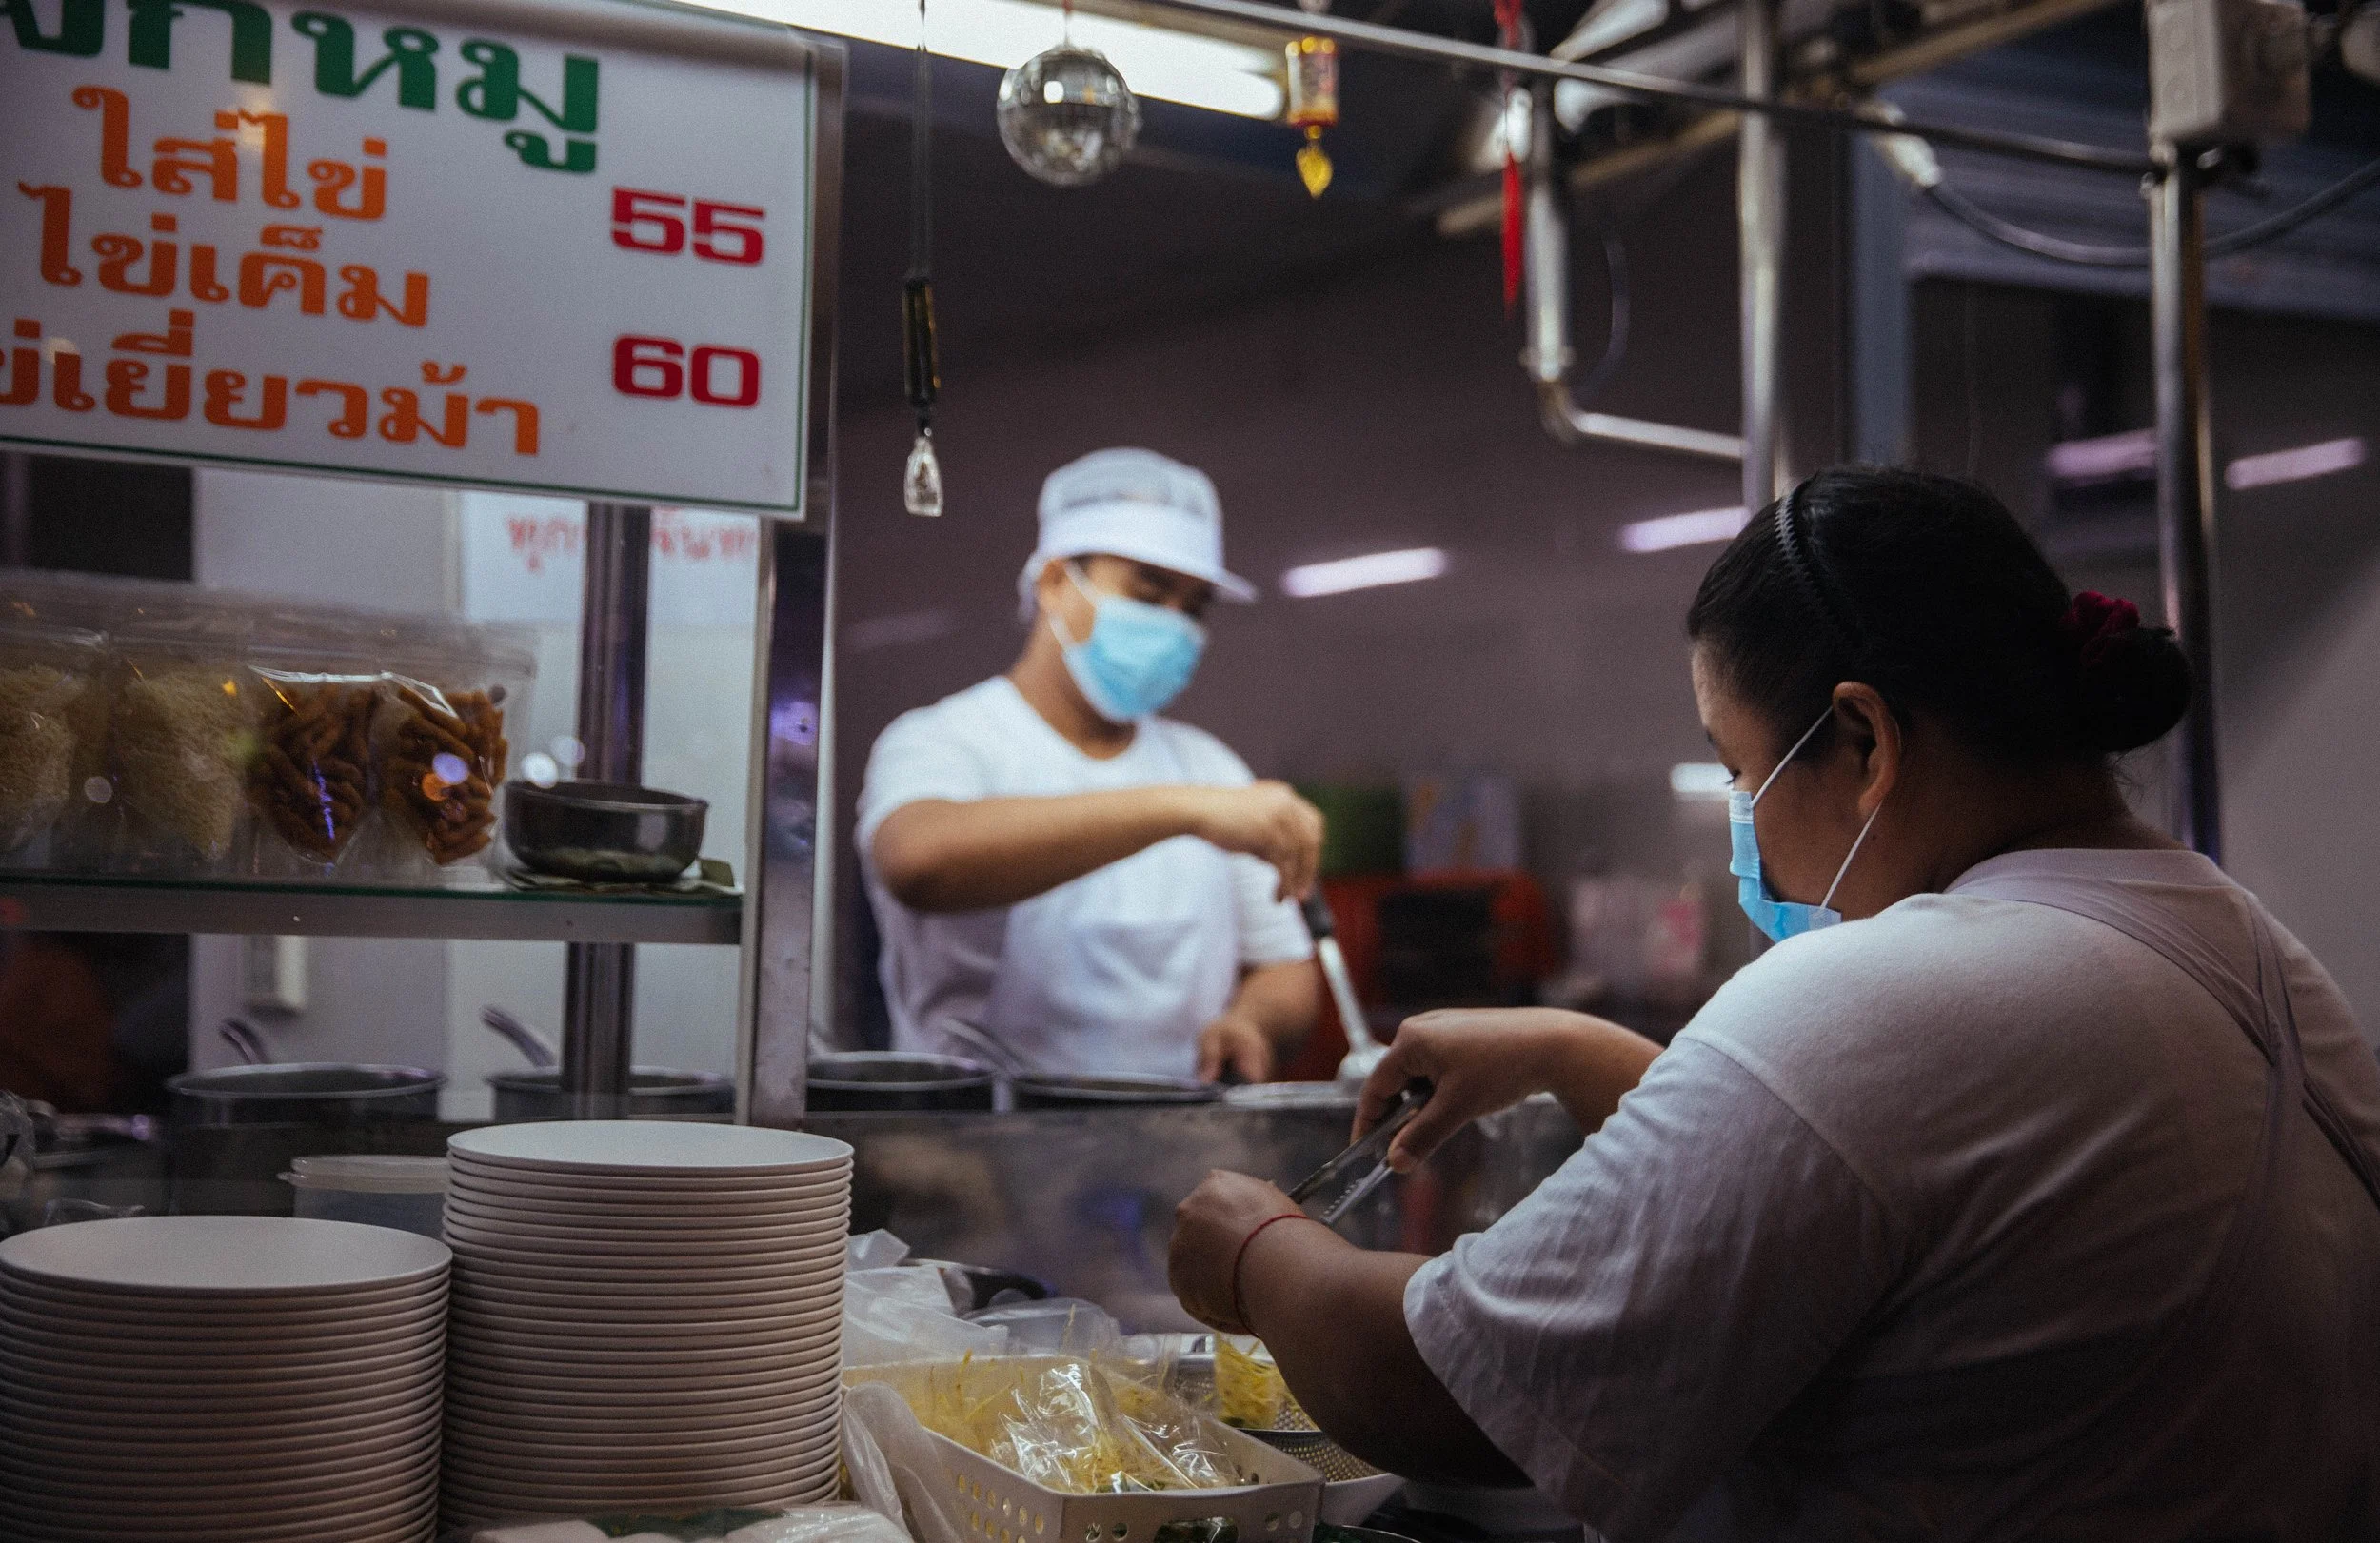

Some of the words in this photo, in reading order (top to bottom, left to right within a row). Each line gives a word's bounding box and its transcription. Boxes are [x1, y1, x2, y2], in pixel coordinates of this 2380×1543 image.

[71, 86, 387, 221] ใส่ไข่
[18, 180, 428, 328] ไข่เค็ม
[611, 187, 765, 267] 55
[612, 334, 761, 408] 60
